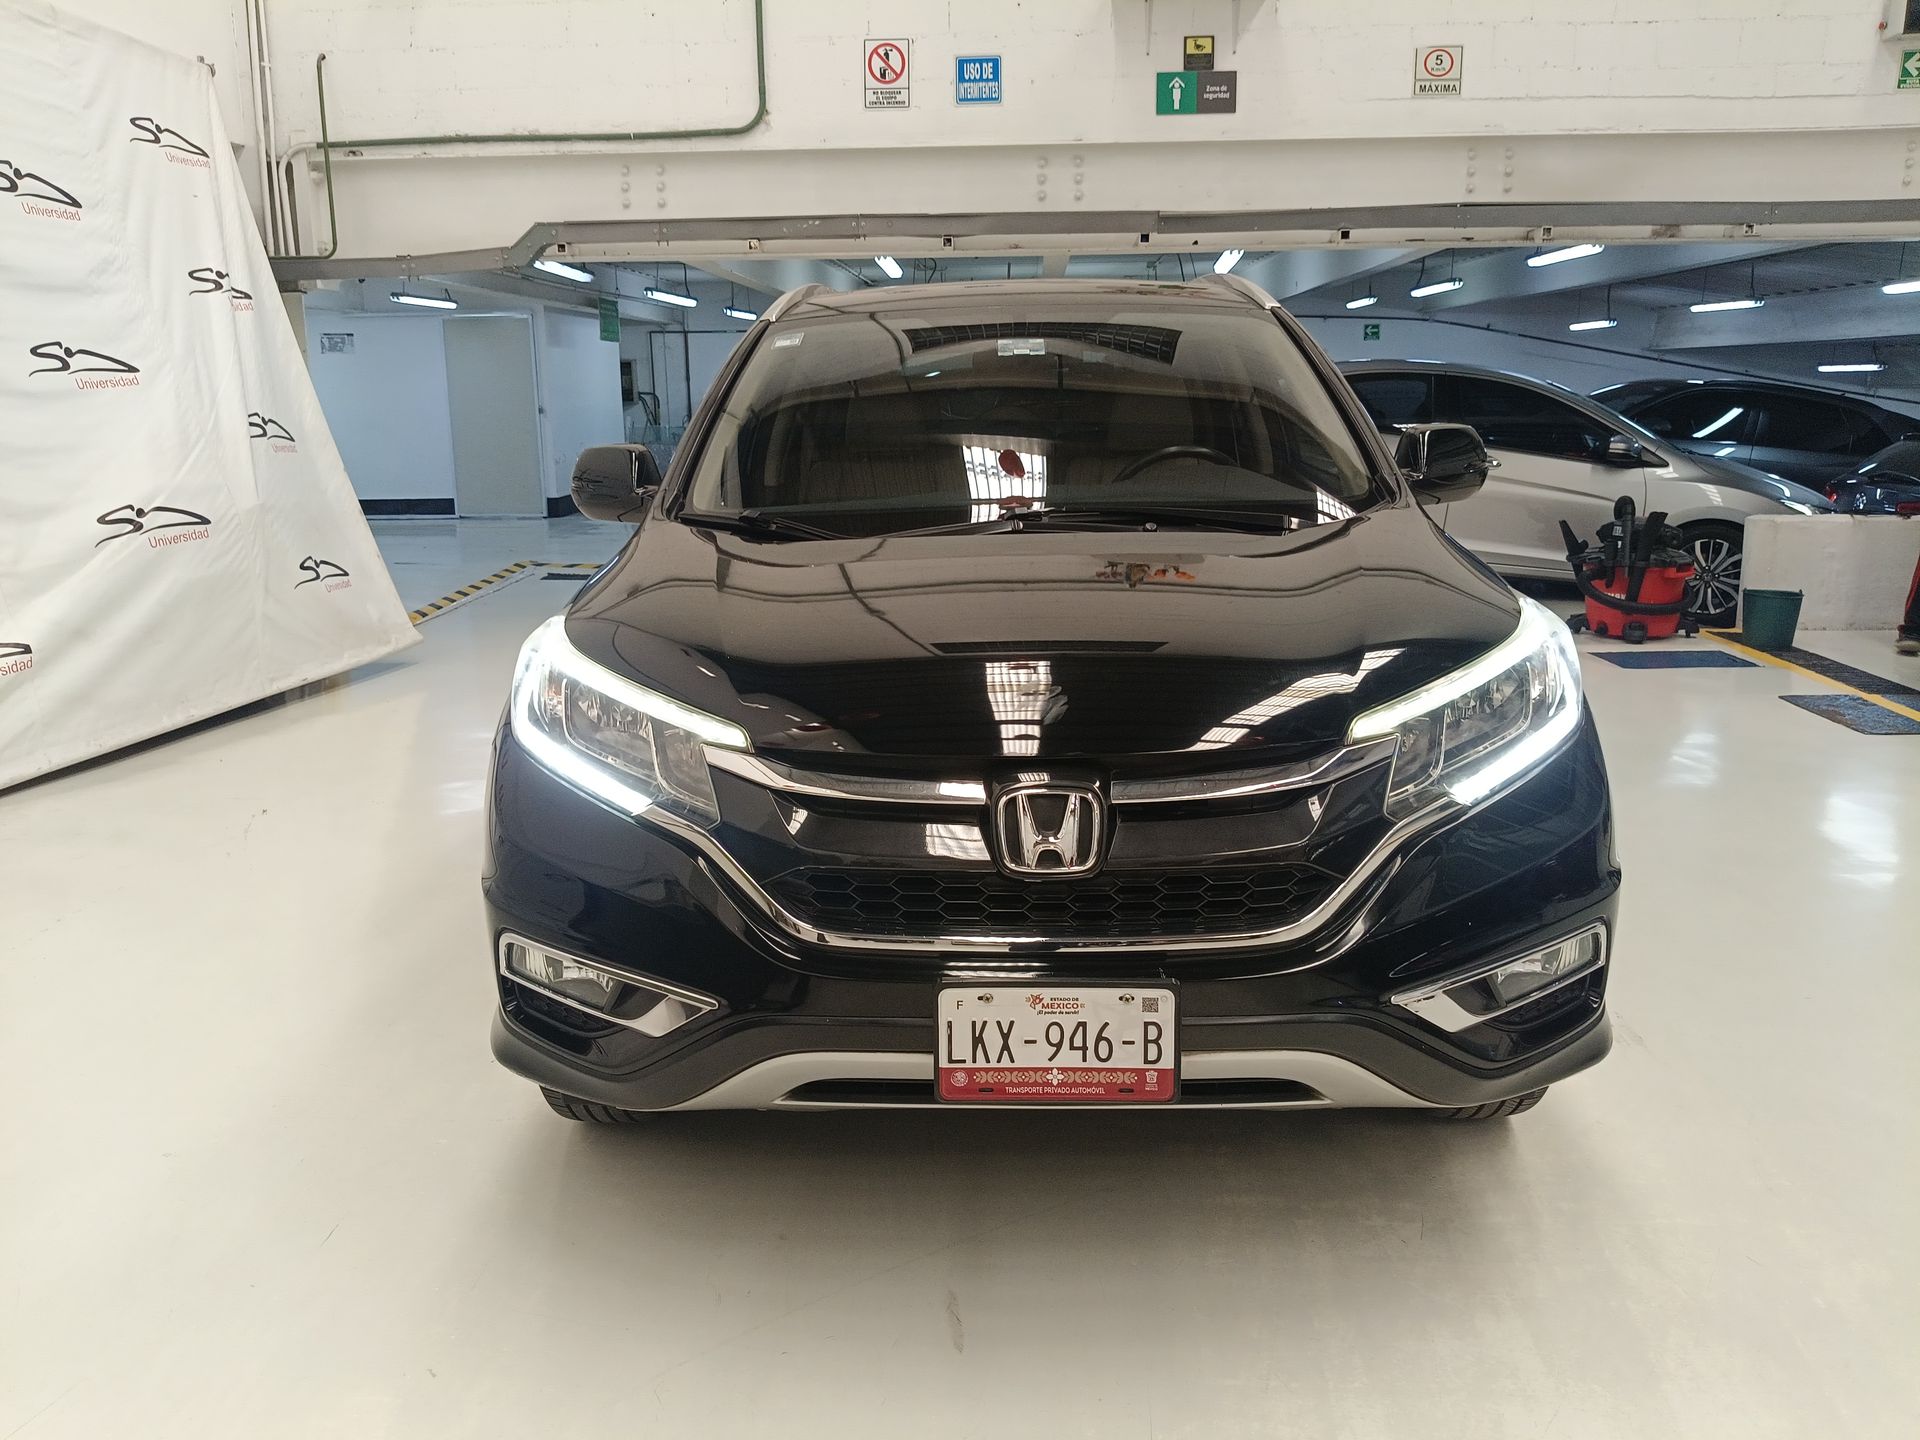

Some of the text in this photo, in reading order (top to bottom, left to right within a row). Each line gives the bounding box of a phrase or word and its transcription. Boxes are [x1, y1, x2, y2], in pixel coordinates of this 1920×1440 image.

[1435, 54, 1443, 66] 5
[964, 62, 993, 80] USO DE
[958, 81, 999, 99] INTERMITENTES
[1203, 92, 1230, 100] seguridad
[21, 201, 81, 222] Universidad
[75, 374, 140, 391] Universidad
[148, 527, 210, 549] Universidad
[956, 1000, 964, 1010] F
[947, 1019, 1163, 1065] LKX-946-B
[1005, 1085, 1106, 1095] TRANSPORTE PRIVADO AUTOMÓVIL
